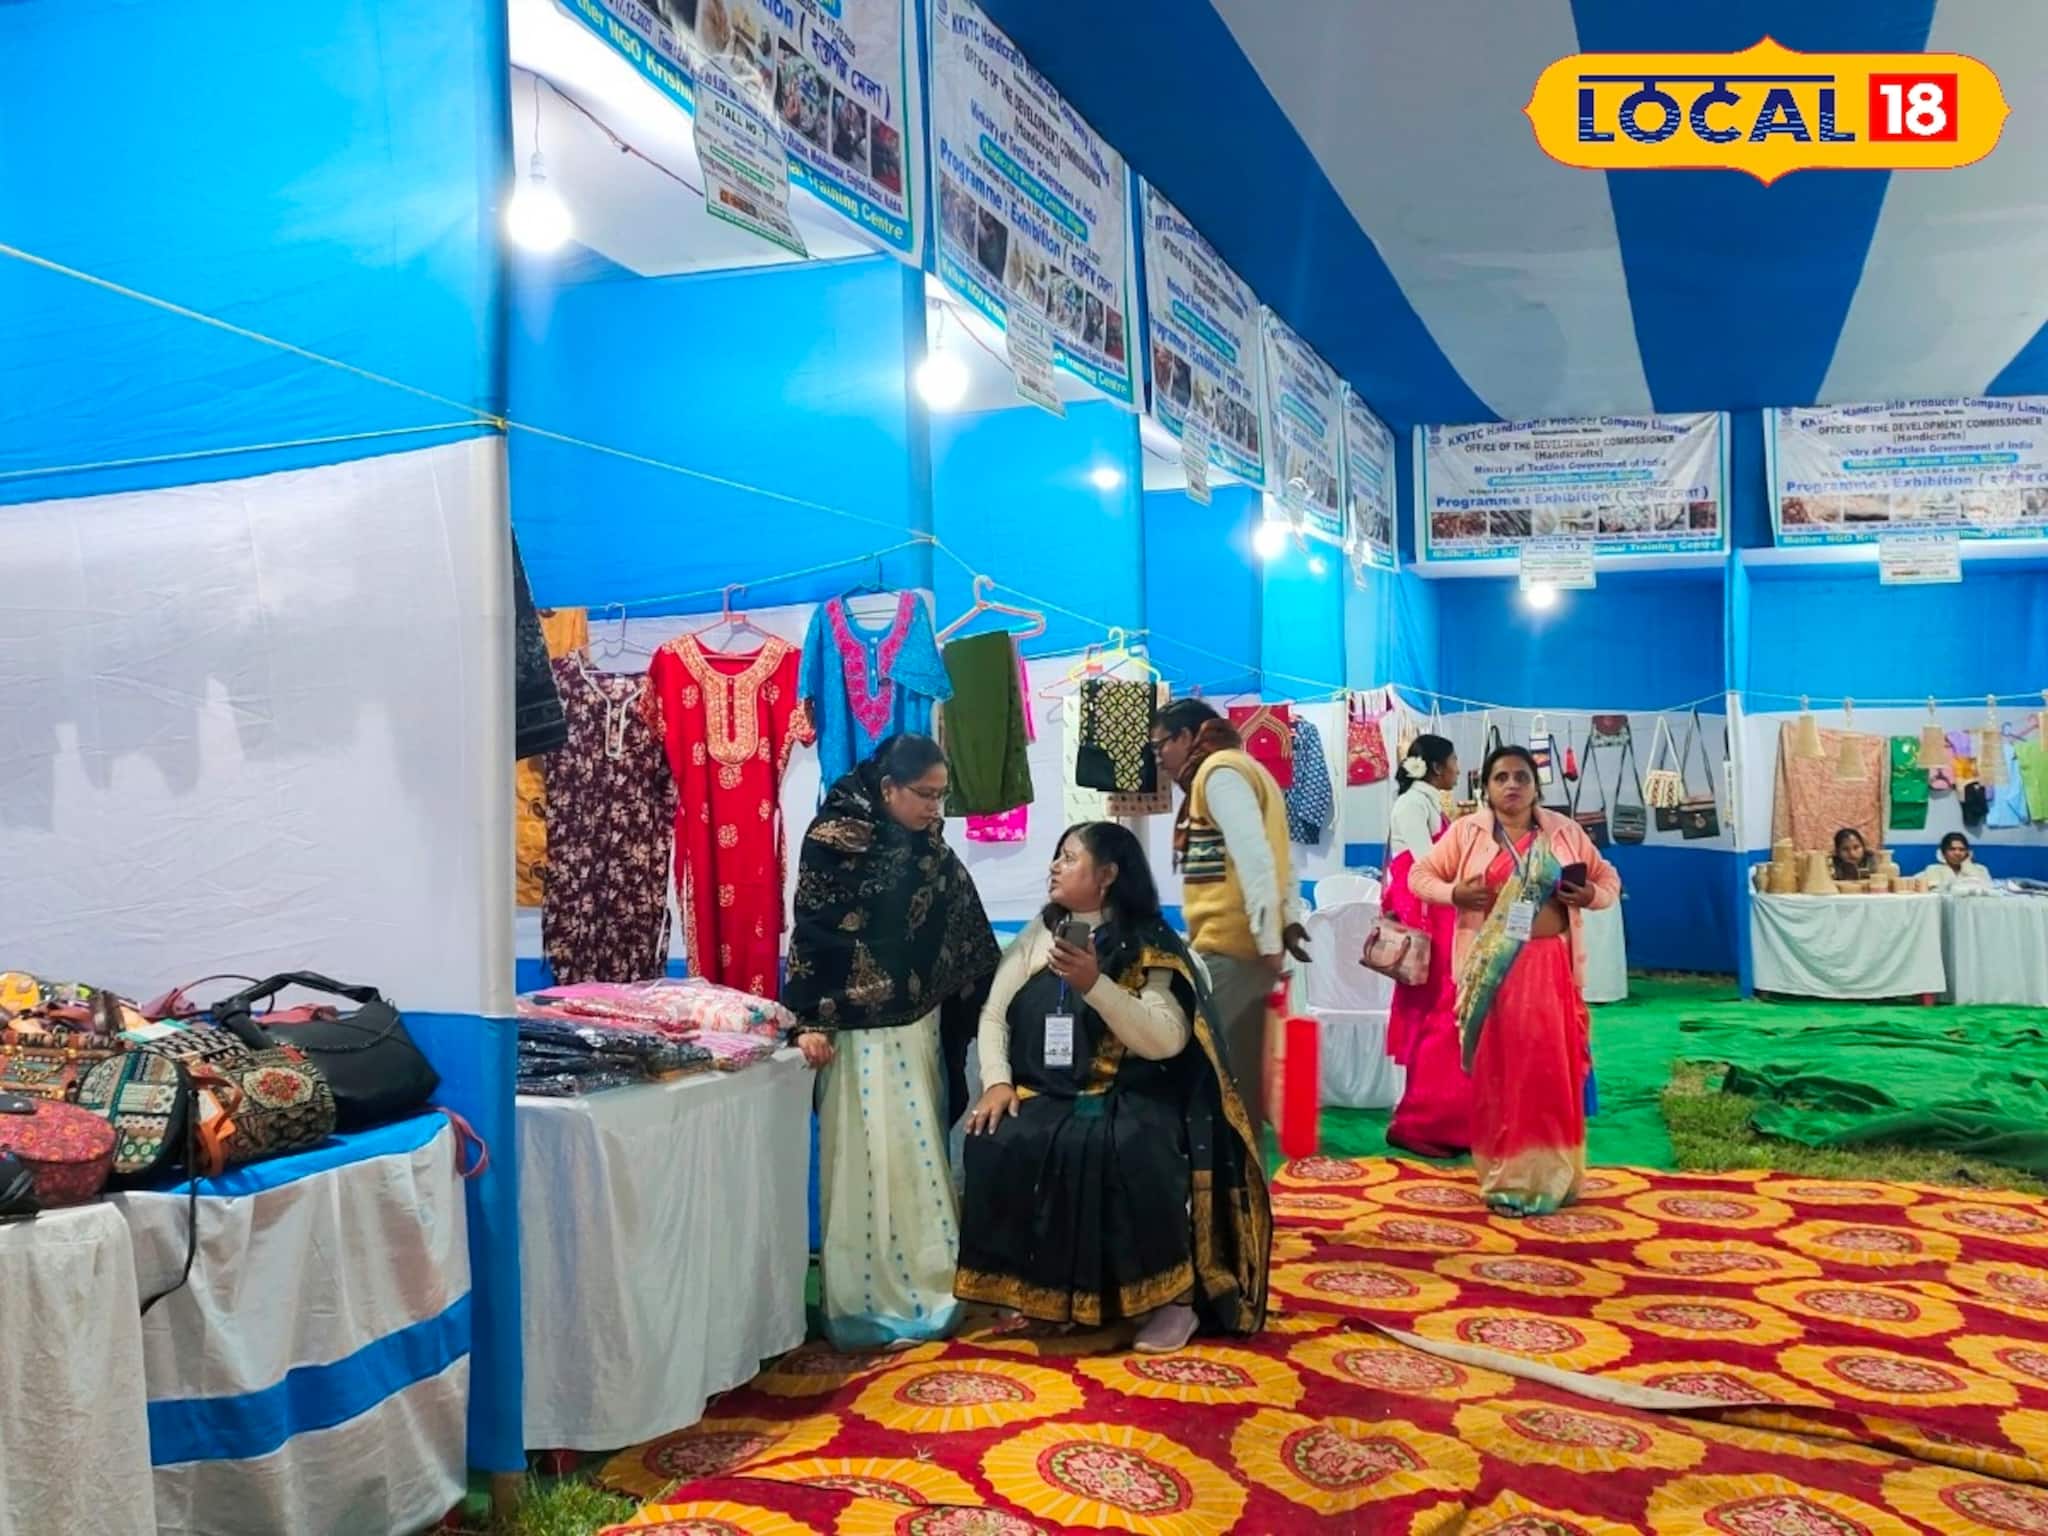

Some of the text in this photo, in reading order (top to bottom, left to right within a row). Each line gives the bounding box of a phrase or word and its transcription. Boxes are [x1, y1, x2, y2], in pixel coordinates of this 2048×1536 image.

[714, 98, 743, 128] STALL
[607, 15, 642, 63] NGO
[646, 48, 692, 106] Krishn
[861, 202, 904, 241] Centre
[940, 136, 1003, 212] Programme
[1010, 201, 1061, 259] Exhibition
[1963, 397, 2014, 412] Company
[1818, 416, 2043, 436] OFFICE OF THE DEVELOPMENT COMMISSIONER
[1465, 441, 1496, 454] OFFICE
[1499, 441, 1511, 453] OF
[1514, 440, 1531, 451] THE
[1603, 433, 1675, 447] COMMISSIONER
[1893, 430, 1966, 443] (Handicrafts)
[1893, 475, 1973, 489] Exhibition
[1437, 494, 1521, 509] Programme
[1535, 490, 1609, 504] Exhibition
